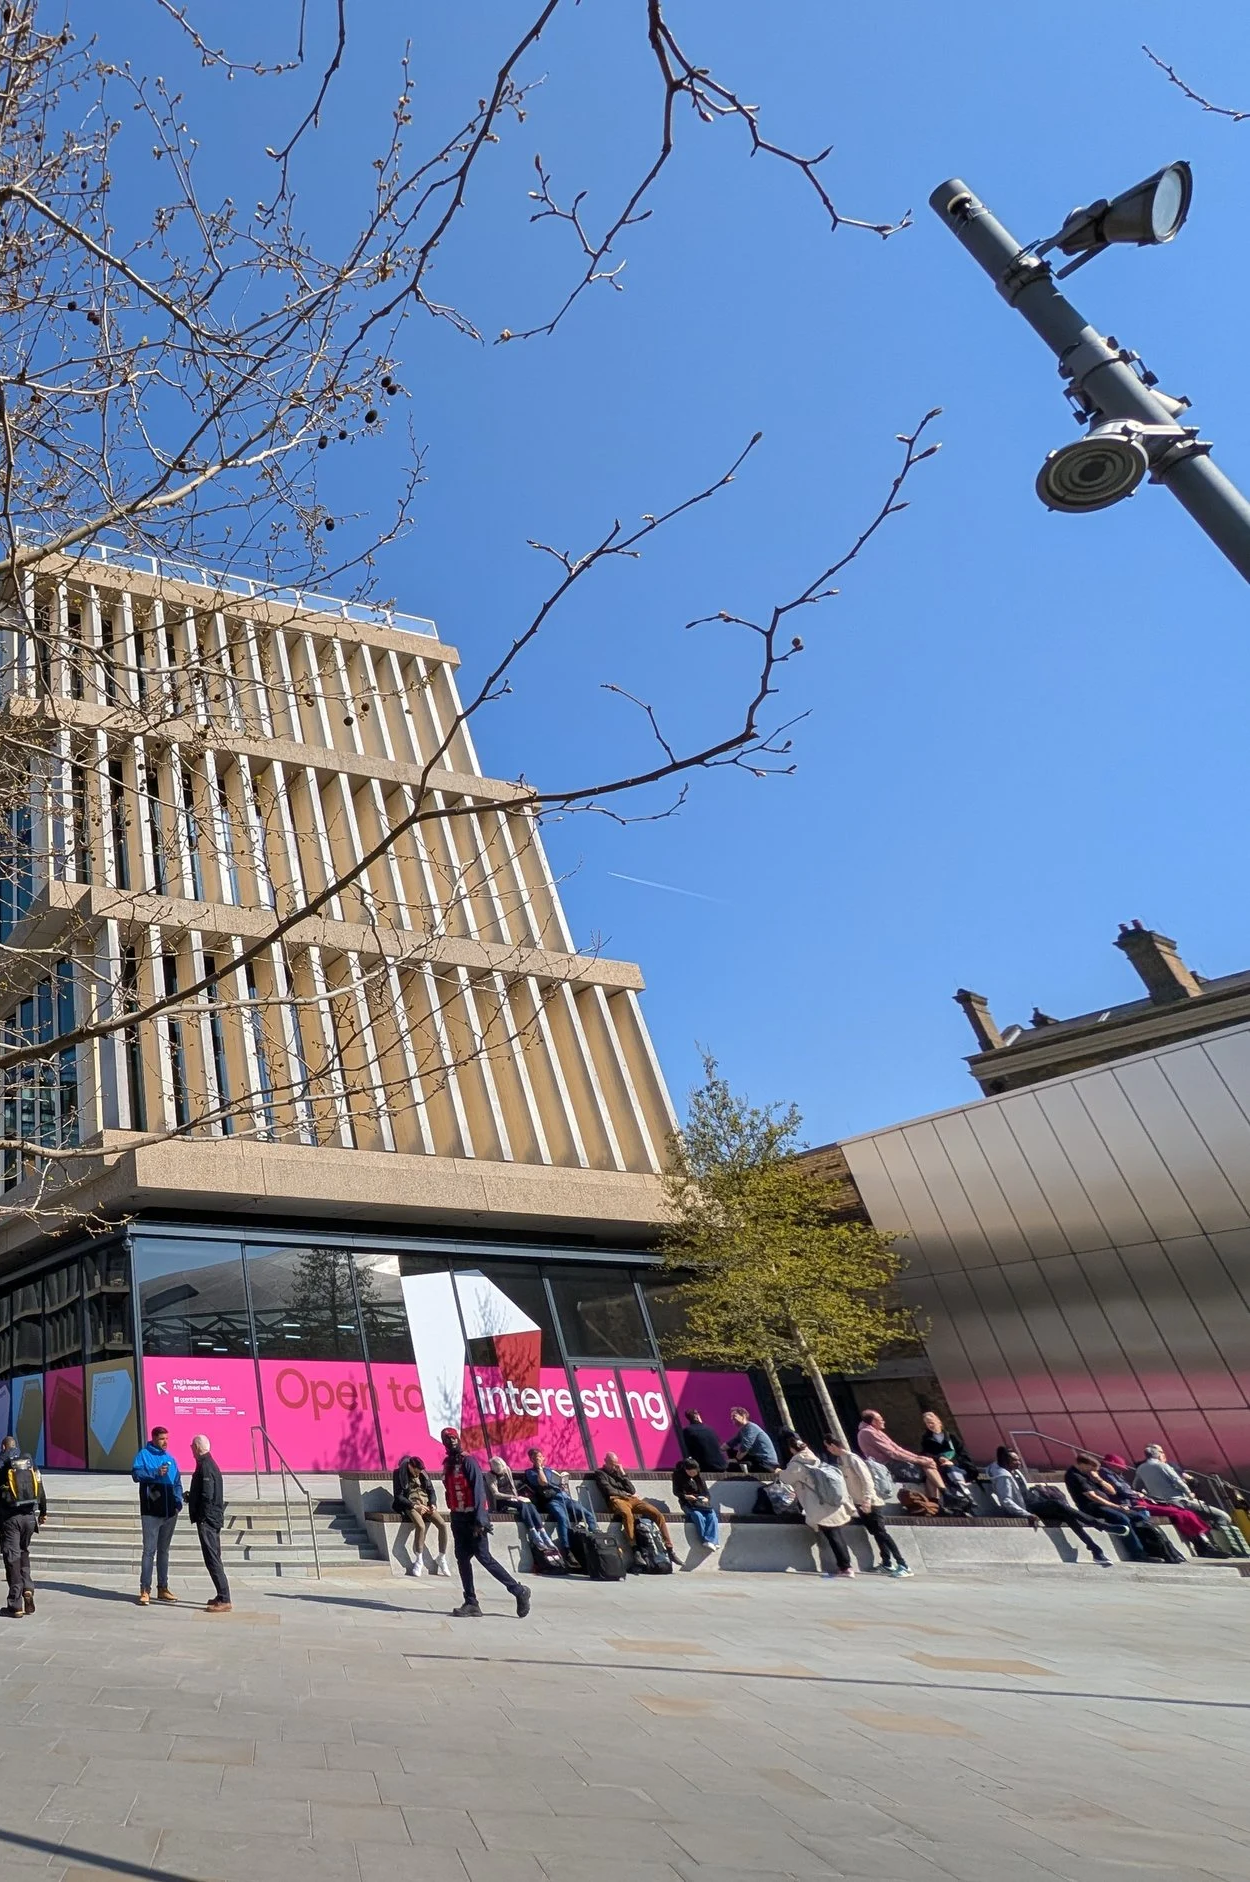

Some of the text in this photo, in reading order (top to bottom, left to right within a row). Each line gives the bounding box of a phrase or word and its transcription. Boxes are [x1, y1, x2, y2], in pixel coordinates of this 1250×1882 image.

[275, 1368, 670, 1431] Open to interesting
